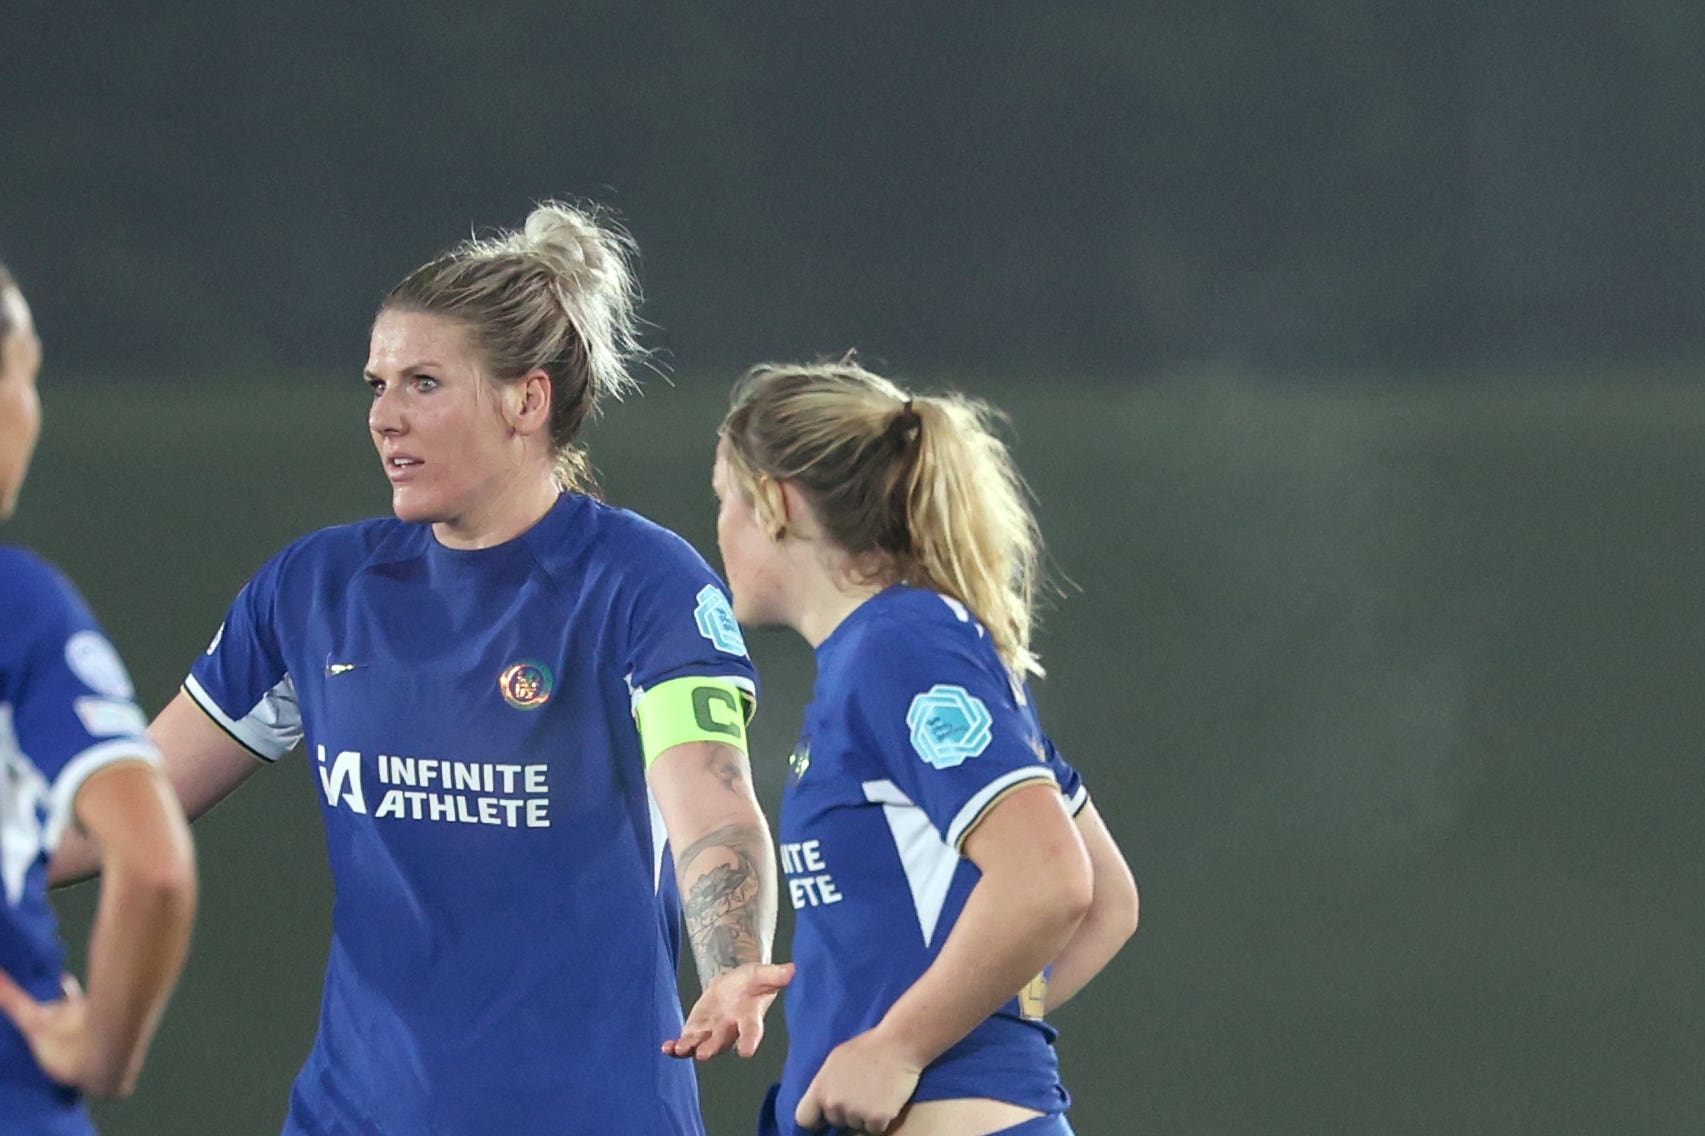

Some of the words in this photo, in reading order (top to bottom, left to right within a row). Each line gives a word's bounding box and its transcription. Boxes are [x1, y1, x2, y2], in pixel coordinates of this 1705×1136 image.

[691, 686, 742, 739] C
[378, 755, 550, 794] INFINITE
[374, 790, 552, 829] ATHLETE
